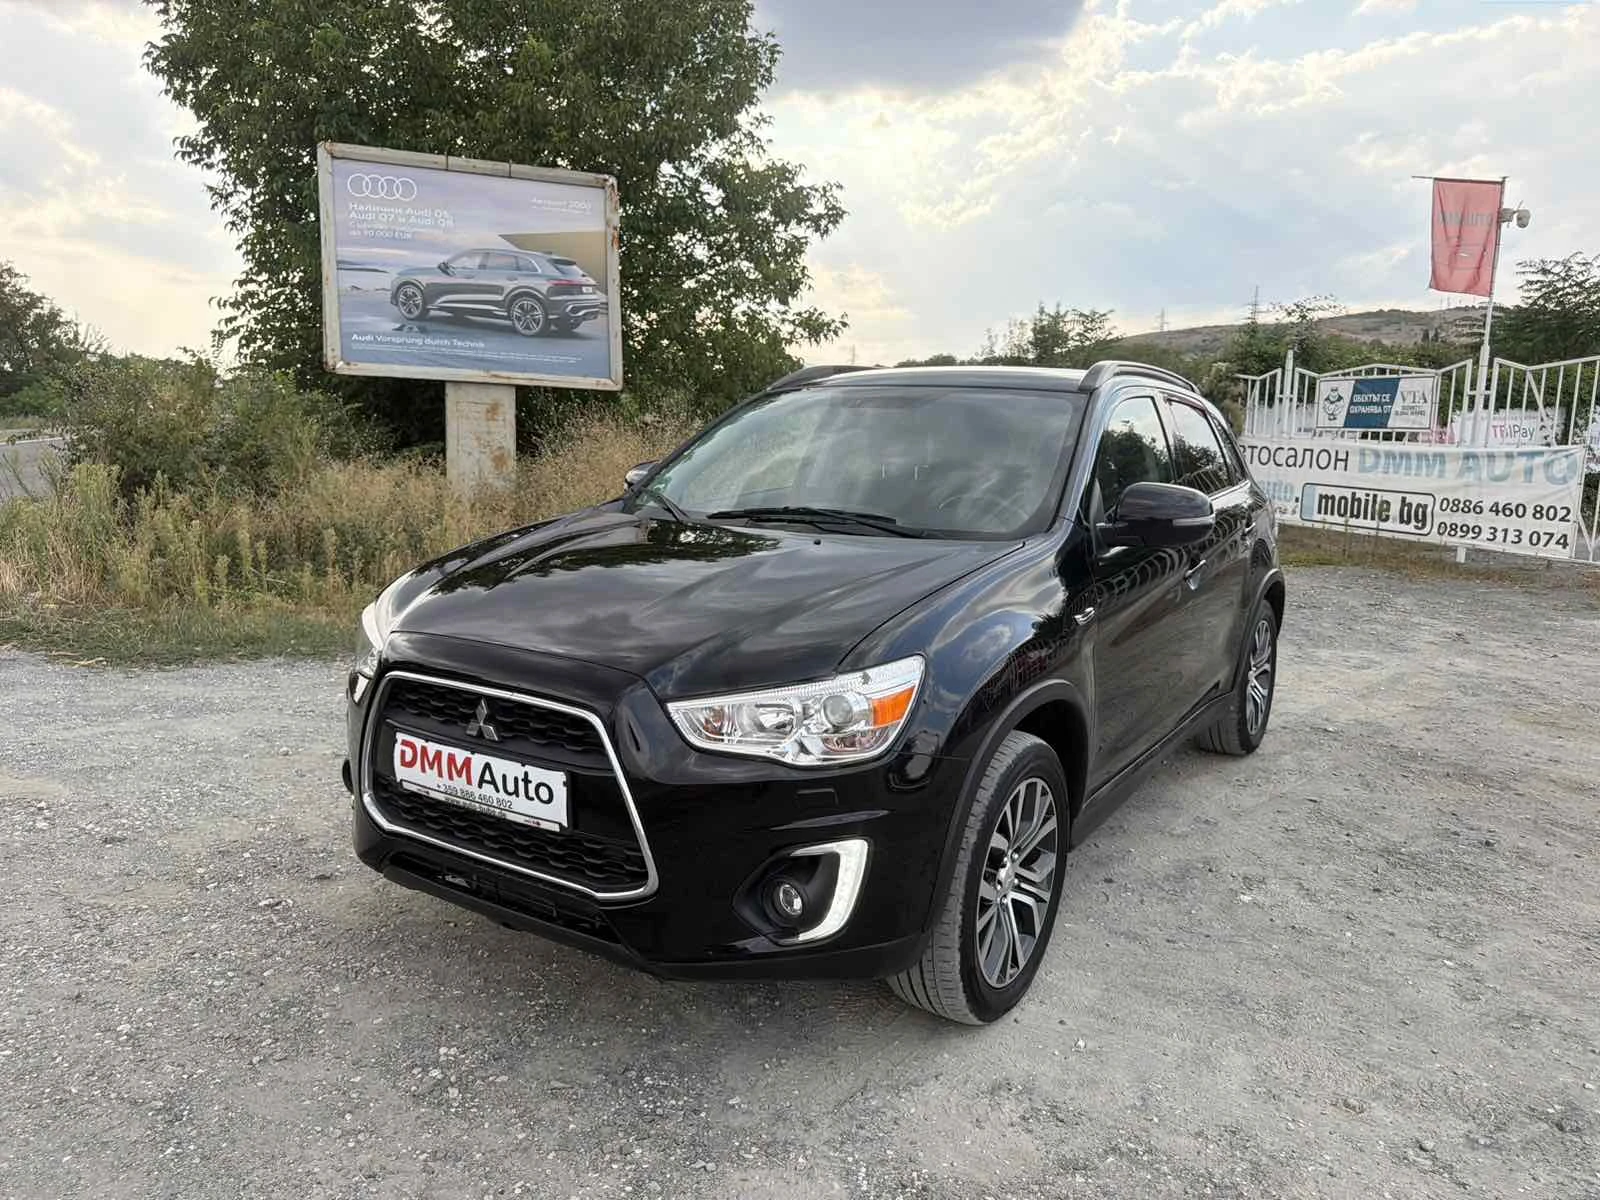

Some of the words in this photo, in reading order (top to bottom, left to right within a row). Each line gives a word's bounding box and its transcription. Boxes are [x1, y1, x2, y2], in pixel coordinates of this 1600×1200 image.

[351, 333, 374, 342] Audi
[375, 335, 423, 346] Vorsprung
[424, 337, 451, 346] durch
[452, 338, 486, 348] Technik
[1381, 393, 1392, 402] СЕ
[1240, 445, 1349, 472] тосалон
[1359, 448, 1447, 479] DMM
[1457, 450, 1578, 486] AUTO
[1439, 497, 1484, 515] 0886
[1488, 501, 1527, 519] 460
[1532, 504, 1572, 523] 802
[1437, 521, 1482, 540] 0899
[1486, 526, 1522, 545] 313
[1528, 531, 1569, 550] 074
[400, 739, 473, 787] DMM
[477, 761, 554, 805] Auto
[477, 793, 495, 806] 460
[496, 797, 513, 810] 802
